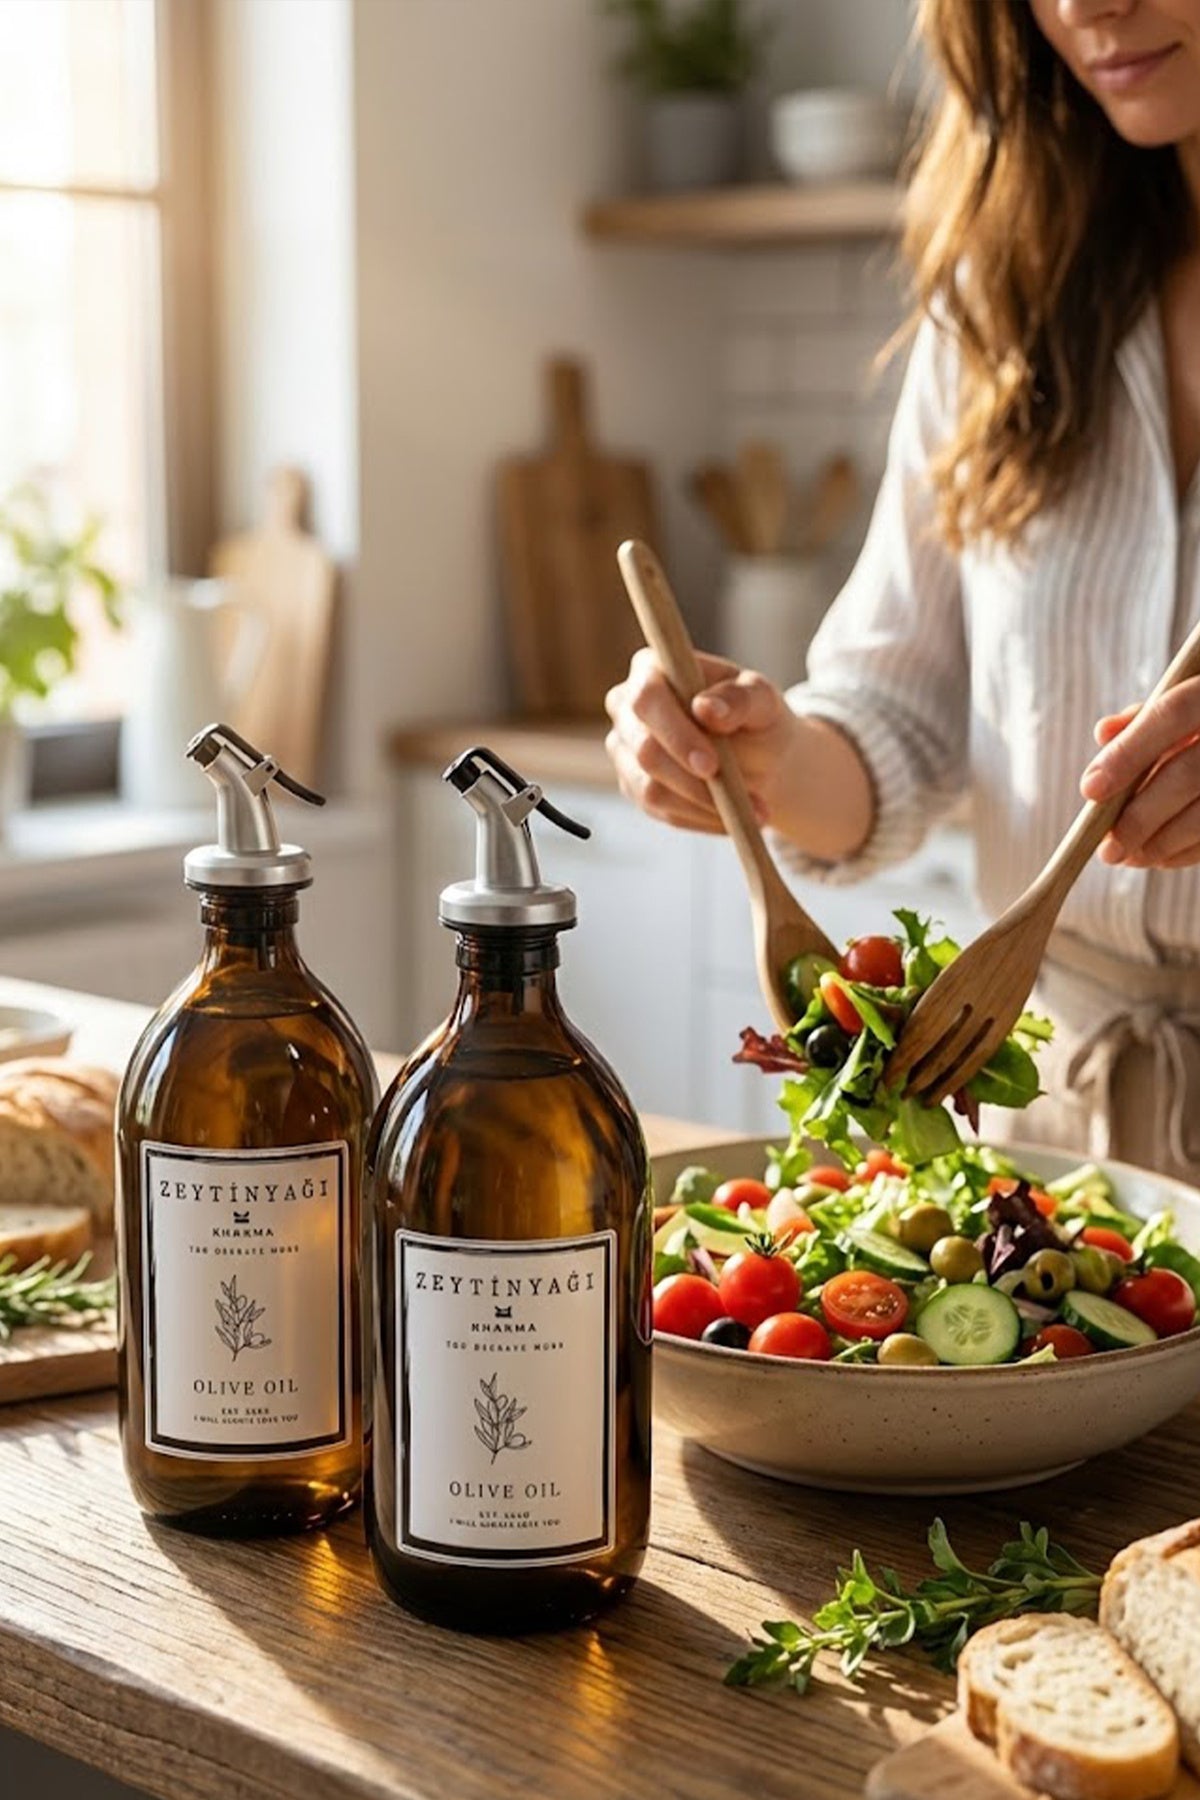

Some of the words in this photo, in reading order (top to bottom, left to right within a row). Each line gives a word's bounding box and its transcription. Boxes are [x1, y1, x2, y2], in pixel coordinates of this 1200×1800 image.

[160, 1178, 328, 1203] ZEYTİNYAĞI
[416, 1270, 595, 1297] ZEYTİNYAĞI
[193, 1379, 255, 1396] OLIVE
[264, 1378, 299, 1394] OIL
[449, 1480, 514, 1499] OLIVE
[524, 1482, 561, 1499] OIL
